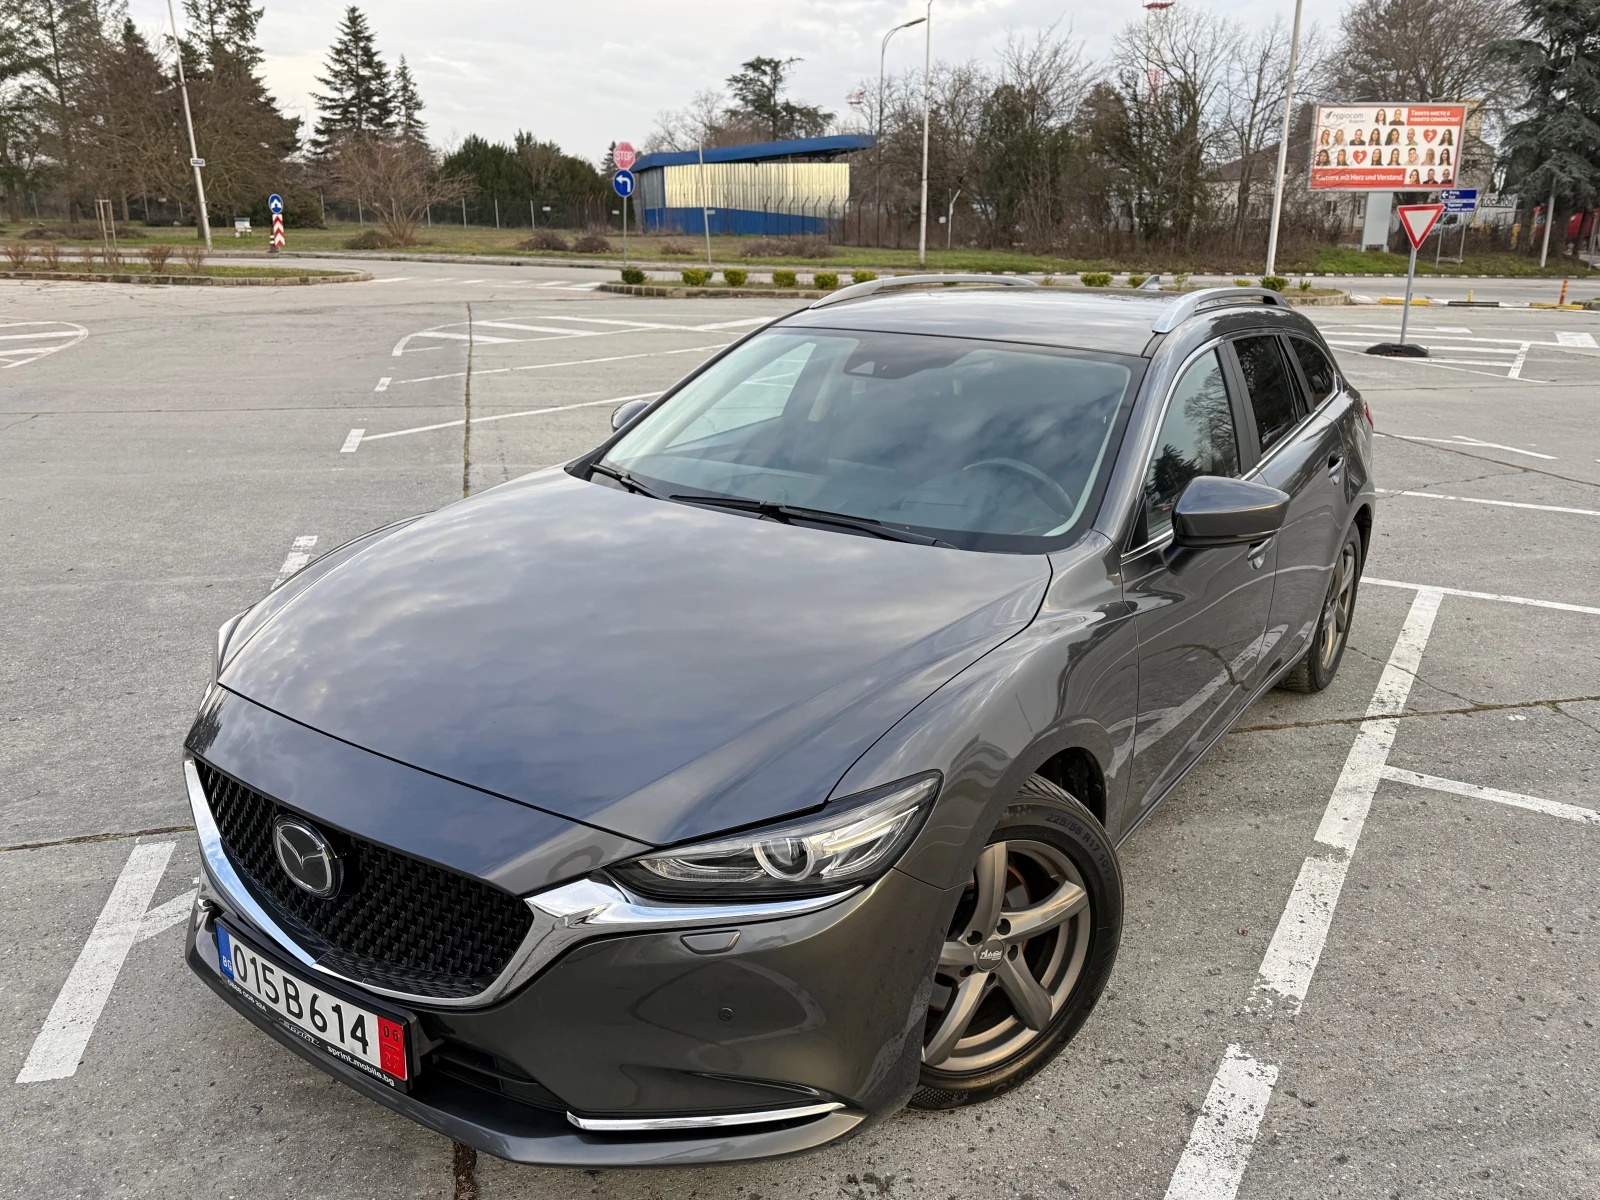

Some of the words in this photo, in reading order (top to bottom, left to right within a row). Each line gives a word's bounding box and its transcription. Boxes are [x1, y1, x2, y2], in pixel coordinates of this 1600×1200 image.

[615, 150, 634, 161] STOP
[1045, 812, 1084, 836] 225/55
[1082, 832, 1101, 852] R17
[222, 955, 233, 972] BG
[233, 944, 369, 1056] 015B614
[383, 1025, 399, 1043] 06
[327, 1046, 395, 1087] sprint.mobile.bg
[384, 1053, 400, 1069] 27
